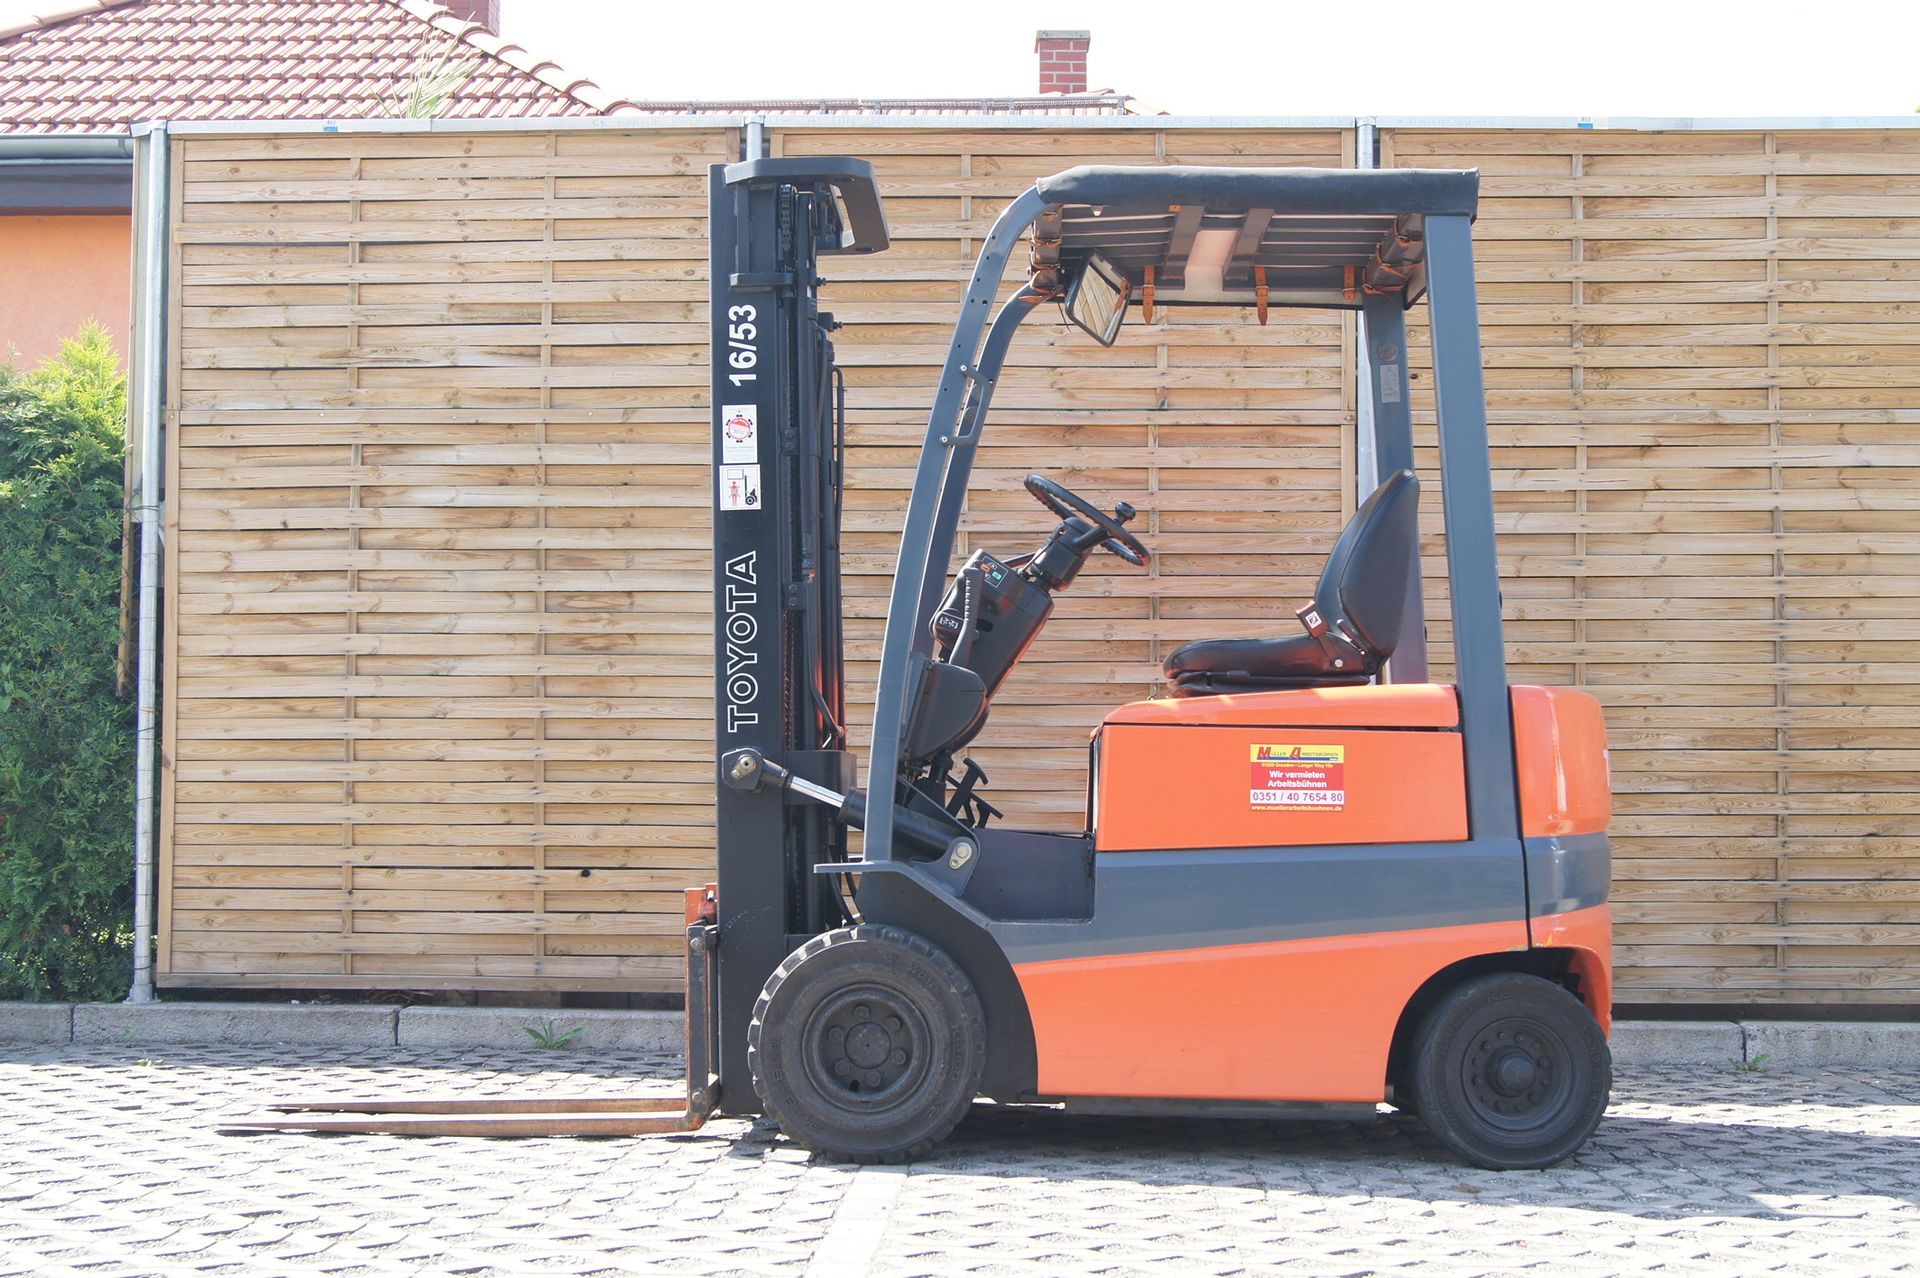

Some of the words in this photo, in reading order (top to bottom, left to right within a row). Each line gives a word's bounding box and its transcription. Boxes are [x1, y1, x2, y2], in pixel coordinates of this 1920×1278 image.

[728, 303, 757, 387] 16/53
[725, 550, 758, 733] TOYOTA
[1285, 771, 1325, 779] vermieten
[1267, 780, 1327, 788] Arbeitsbühnen
[1252, 792, 1277, 801] 0351
[1287, 792, 1299, 801] 40
[1303, 793, 1327, 801] 7654
[1331, 793, 1343, 802] 80
